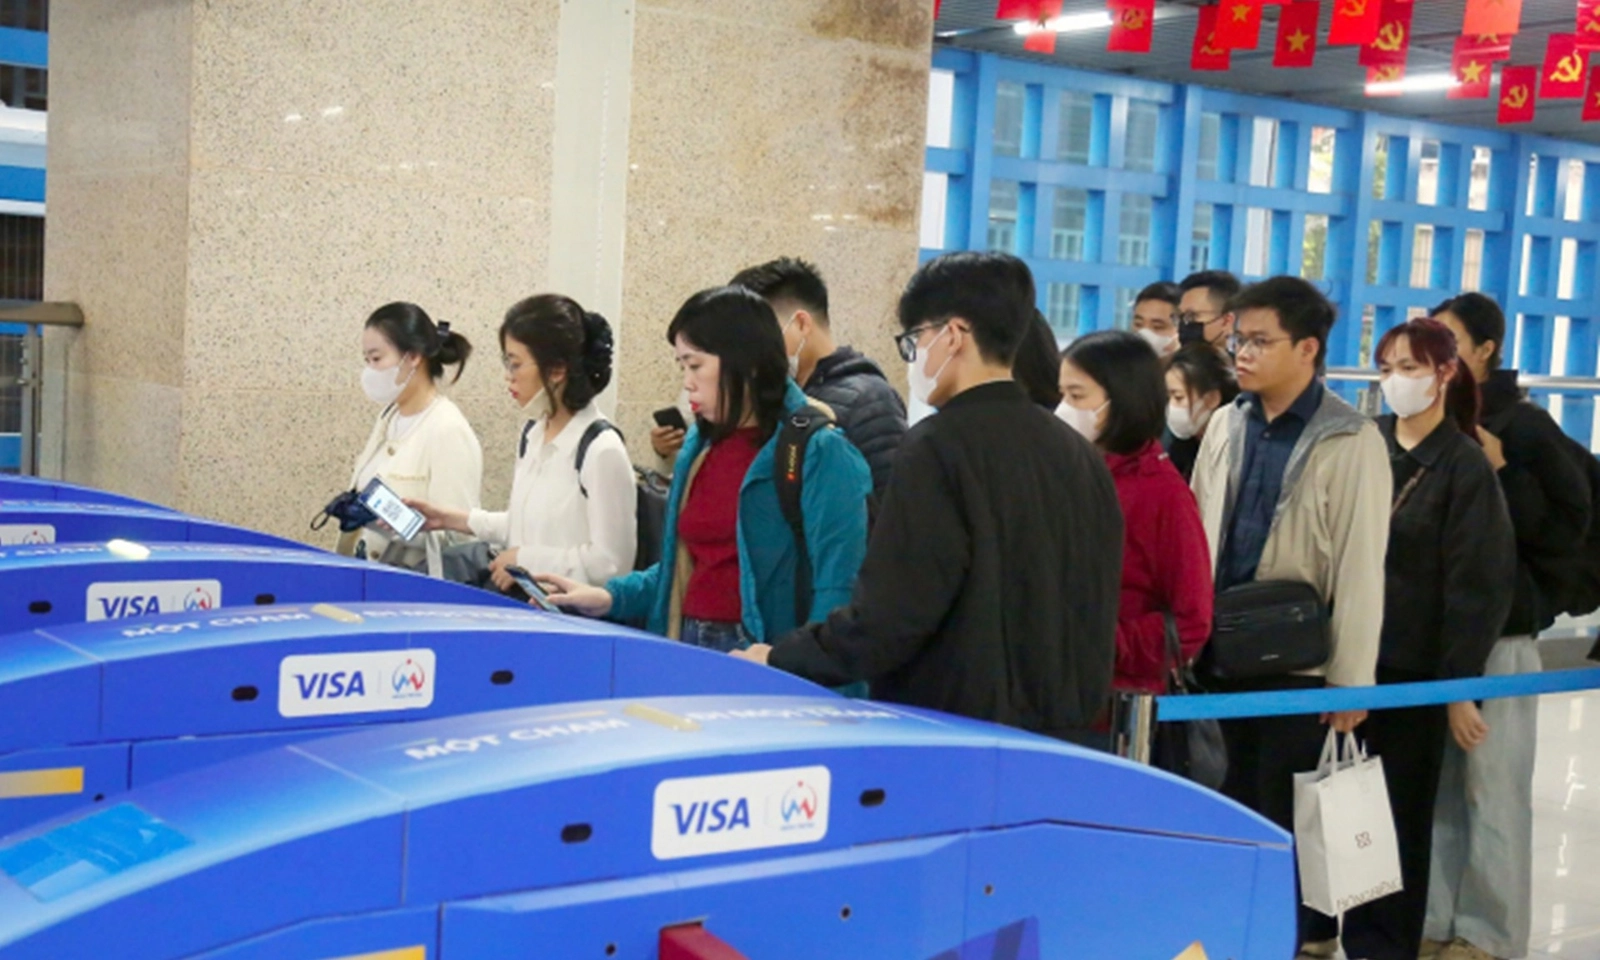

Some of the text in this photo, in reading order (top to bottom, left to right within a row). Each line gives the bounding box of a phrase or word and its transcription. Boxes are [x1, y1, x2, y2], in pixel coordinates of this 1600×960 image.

[98, 596, 161, 618] VISA
[292, 670, 366, 700] VISA
[667, 797, 750, 836] VISA
